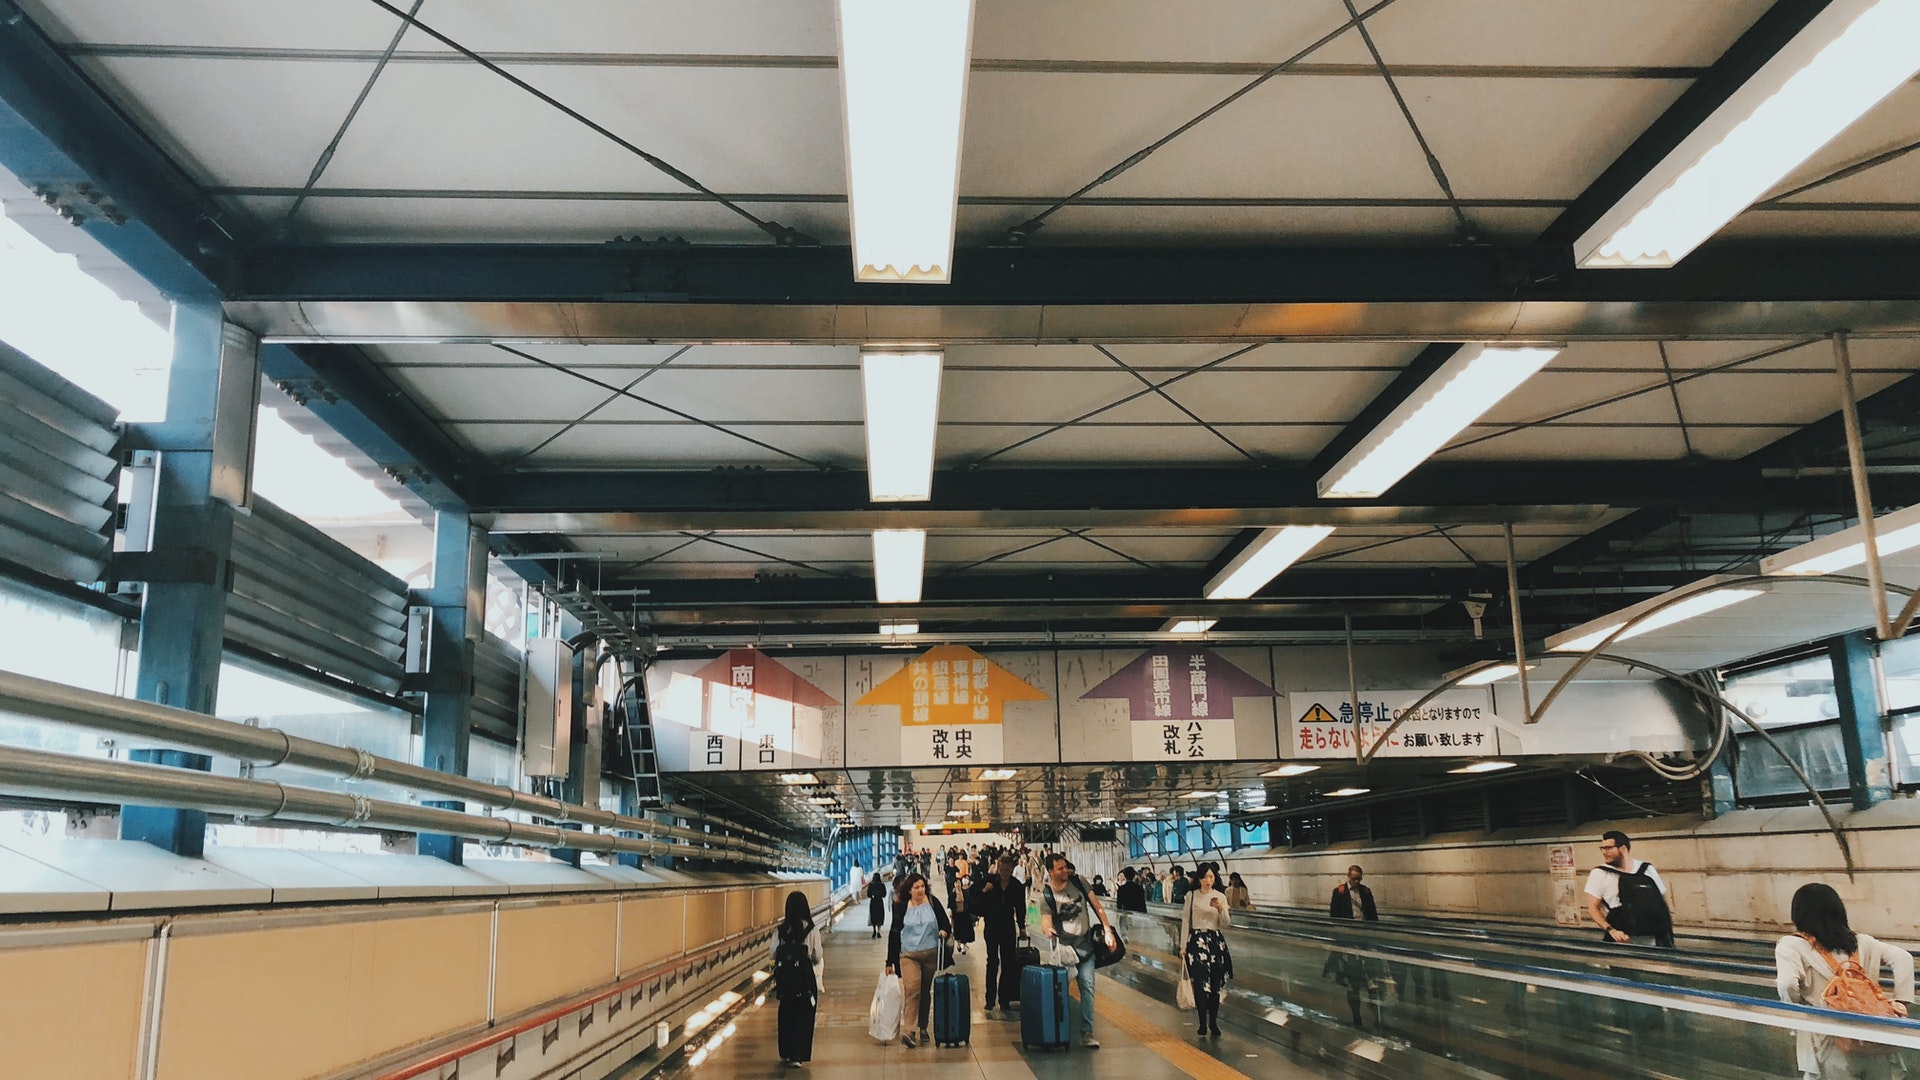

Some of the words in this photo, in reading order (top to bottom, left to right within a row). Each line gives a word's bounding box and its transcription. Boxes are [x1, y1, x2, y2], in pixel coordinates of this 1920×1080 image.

[912, 662, 929, 722] 井の頭線
[932, 660, 949, 705] 銀座線
[952, 660, 969, 705] 東横線
[972, 659, 989, 720] 副都心線
[1152, 655, 1172, 717] 田園都市線
[1189, 654, 1209, 717] 半蔵門線
[707, 735, 723, 765] 西口
[759, 734, 775, 764] 東口
[932, 729, 949, 759] 改札
[955, 728, 972, 759] 中央
[1162, 724, 1182, 755] 改札
[1187, 722, 1205, 758] ハチ公
